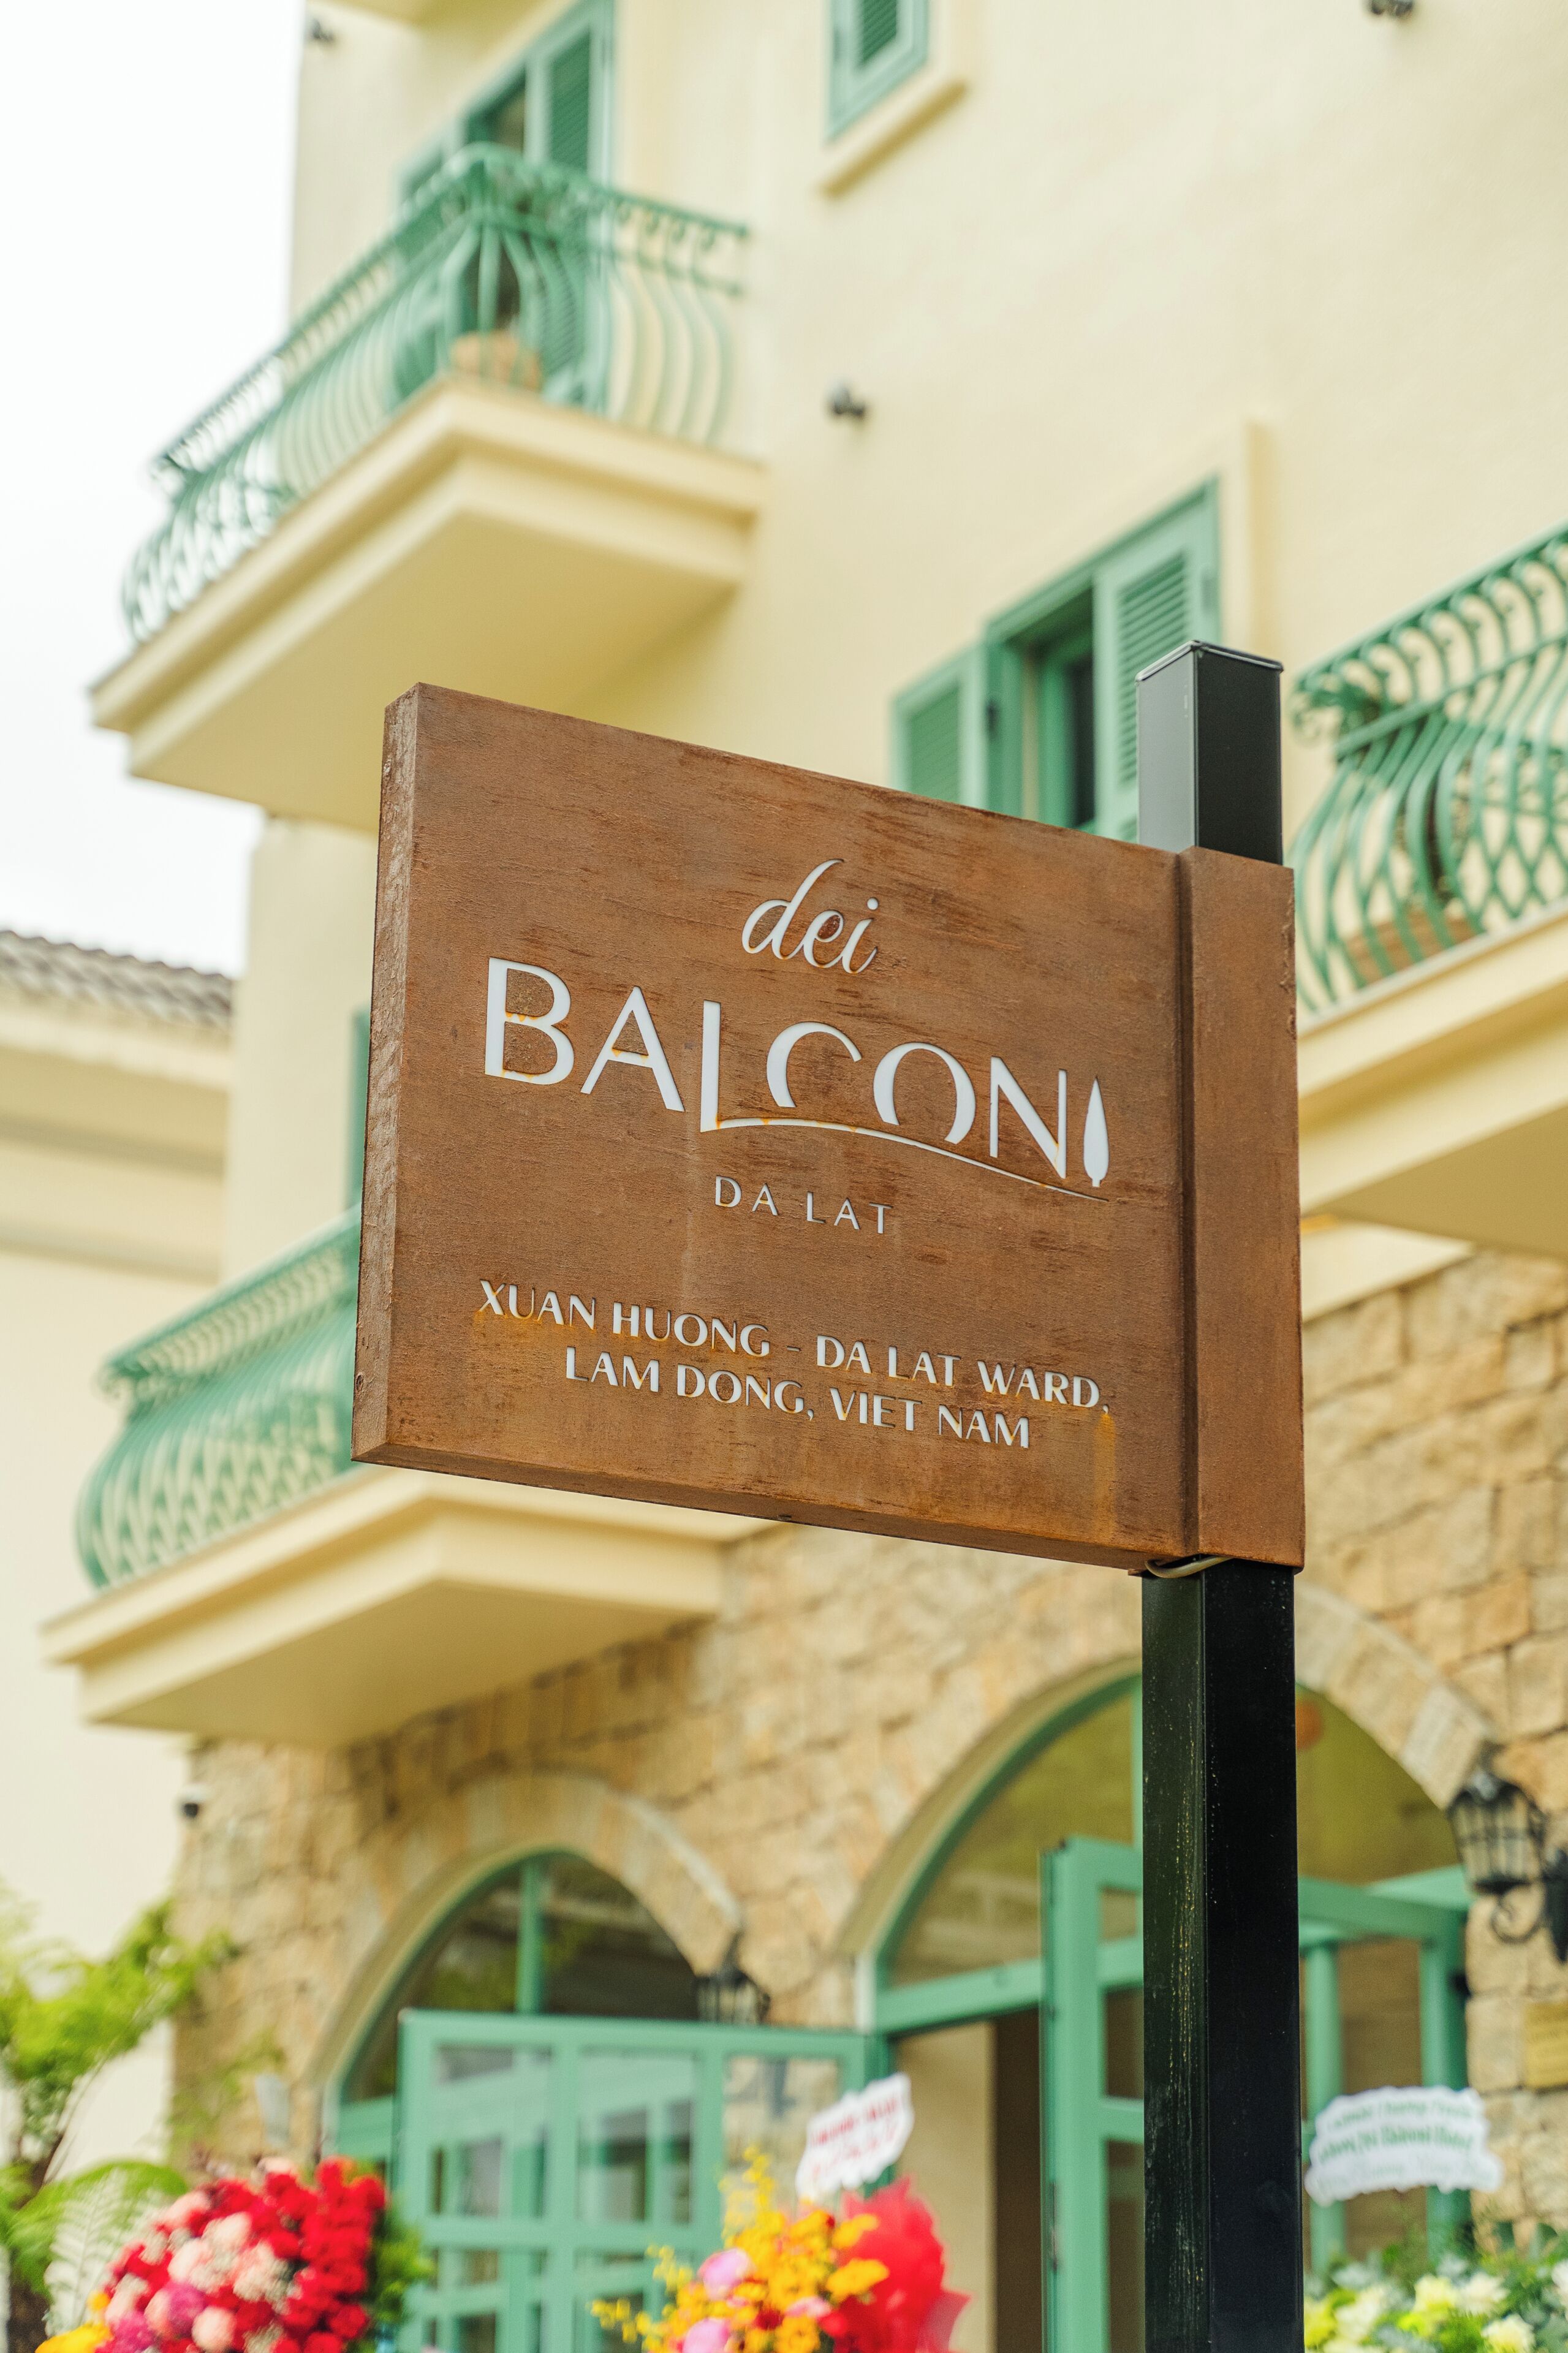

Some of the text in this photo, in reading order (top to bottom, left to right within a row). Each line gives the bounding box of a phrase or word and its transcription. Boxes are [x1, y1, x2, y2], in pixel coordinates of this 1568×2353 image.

[741, 859, 879, 974] dei
[714, 1175, 893, 1235] DA LAT
[479, 1279, 597, 1330] XUAN
[613, 1302, 771, 1357] HUONG
[816, 1335, 872, 1374] DA
[888, 1346, 962, 1387] LAT
[977, 1360, 1110, 1415] WARD,
[566, 1346, 1030, 1449] LAM DONG, VIET NAM
